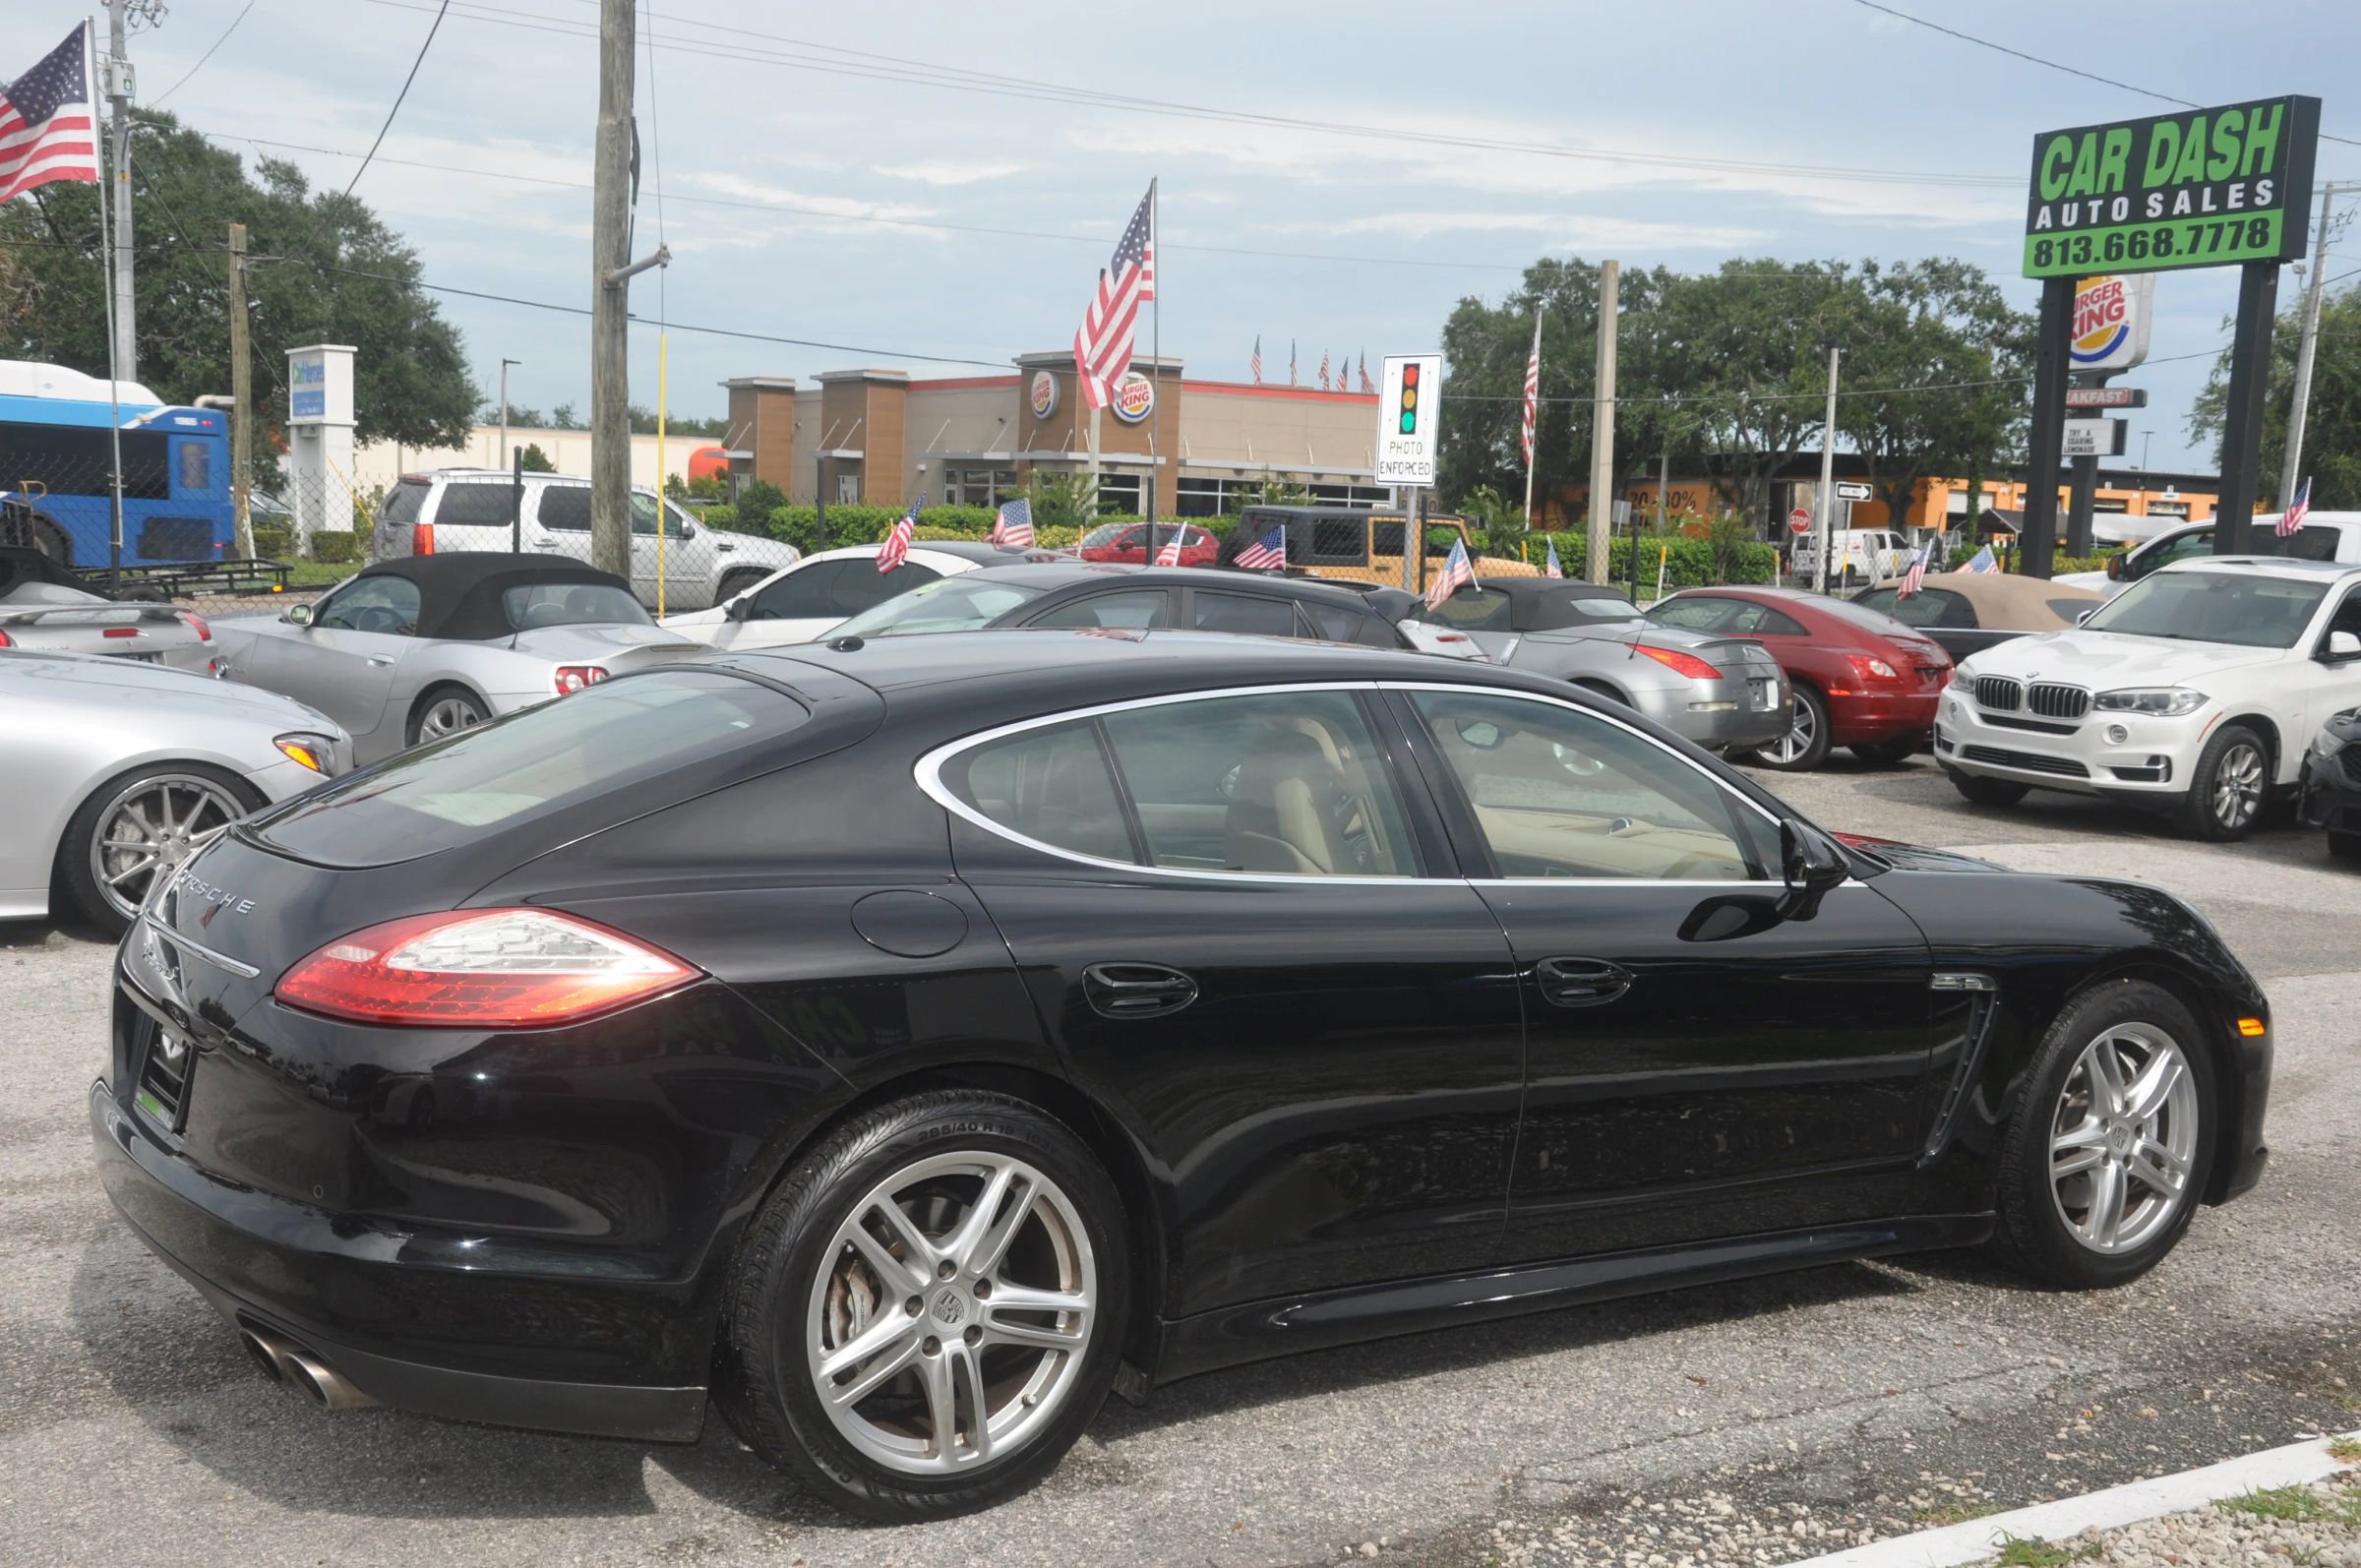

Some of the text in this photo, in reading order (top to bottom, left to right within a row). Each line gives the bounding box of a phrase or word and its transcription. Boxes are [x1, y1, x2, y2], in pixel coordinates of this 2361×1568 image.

[2039, 103, 2284, 202] CAR DASH
[2034, 179, 2274, 230] AUTO SALES
[2033, 217, 2270, 268] 813.668.7778
[2073, 281, 2123, 314] URGER
[1120, 392, 1150, 408] KING
[2066, 391, 2124, 403] EAKFAST
[1389, 441, 1423, 454] PHOTO
[1379, 460, 1431, 475] ENFORCED
[1790, 515, 1809, 526] STOP
